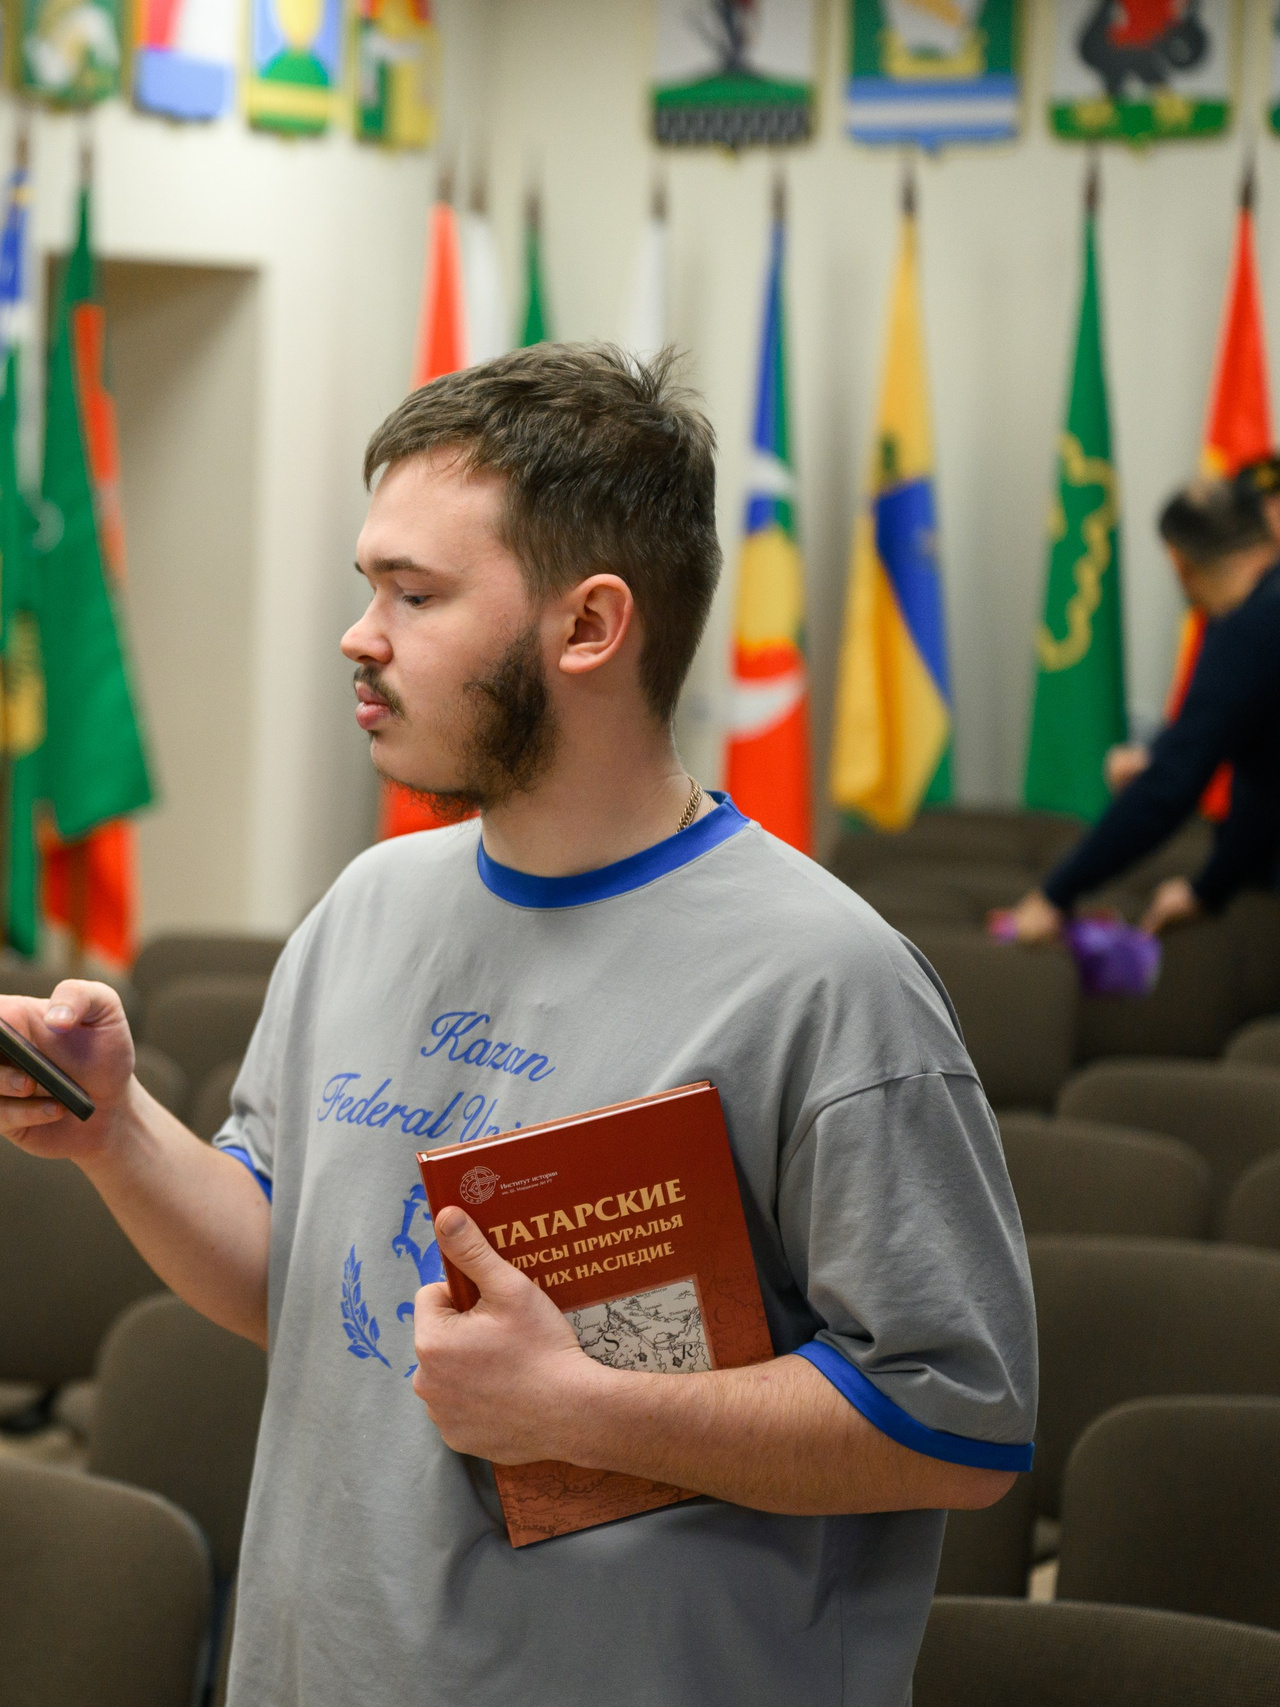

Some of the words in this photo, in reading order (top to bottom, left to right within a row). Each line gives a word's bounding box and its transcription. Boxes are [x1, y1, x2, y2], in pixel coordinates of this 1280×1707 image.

[420, 1011, 556, 1082] Kazan
[317, 1072, 465, 1140] Federal
[500, 1178, 530, 1190] Институт
[531, 1171, 558, 1182] истории
[488, 1178, 686, 1250] ТАТАРСКИЕ
[573, 1214, 684, 1255] ПРИУРАЛЬЯ
[544, 1268, 574, 1288] ИХ
[575, 1241, 675, 1280] НАСЛЕДИЕ
